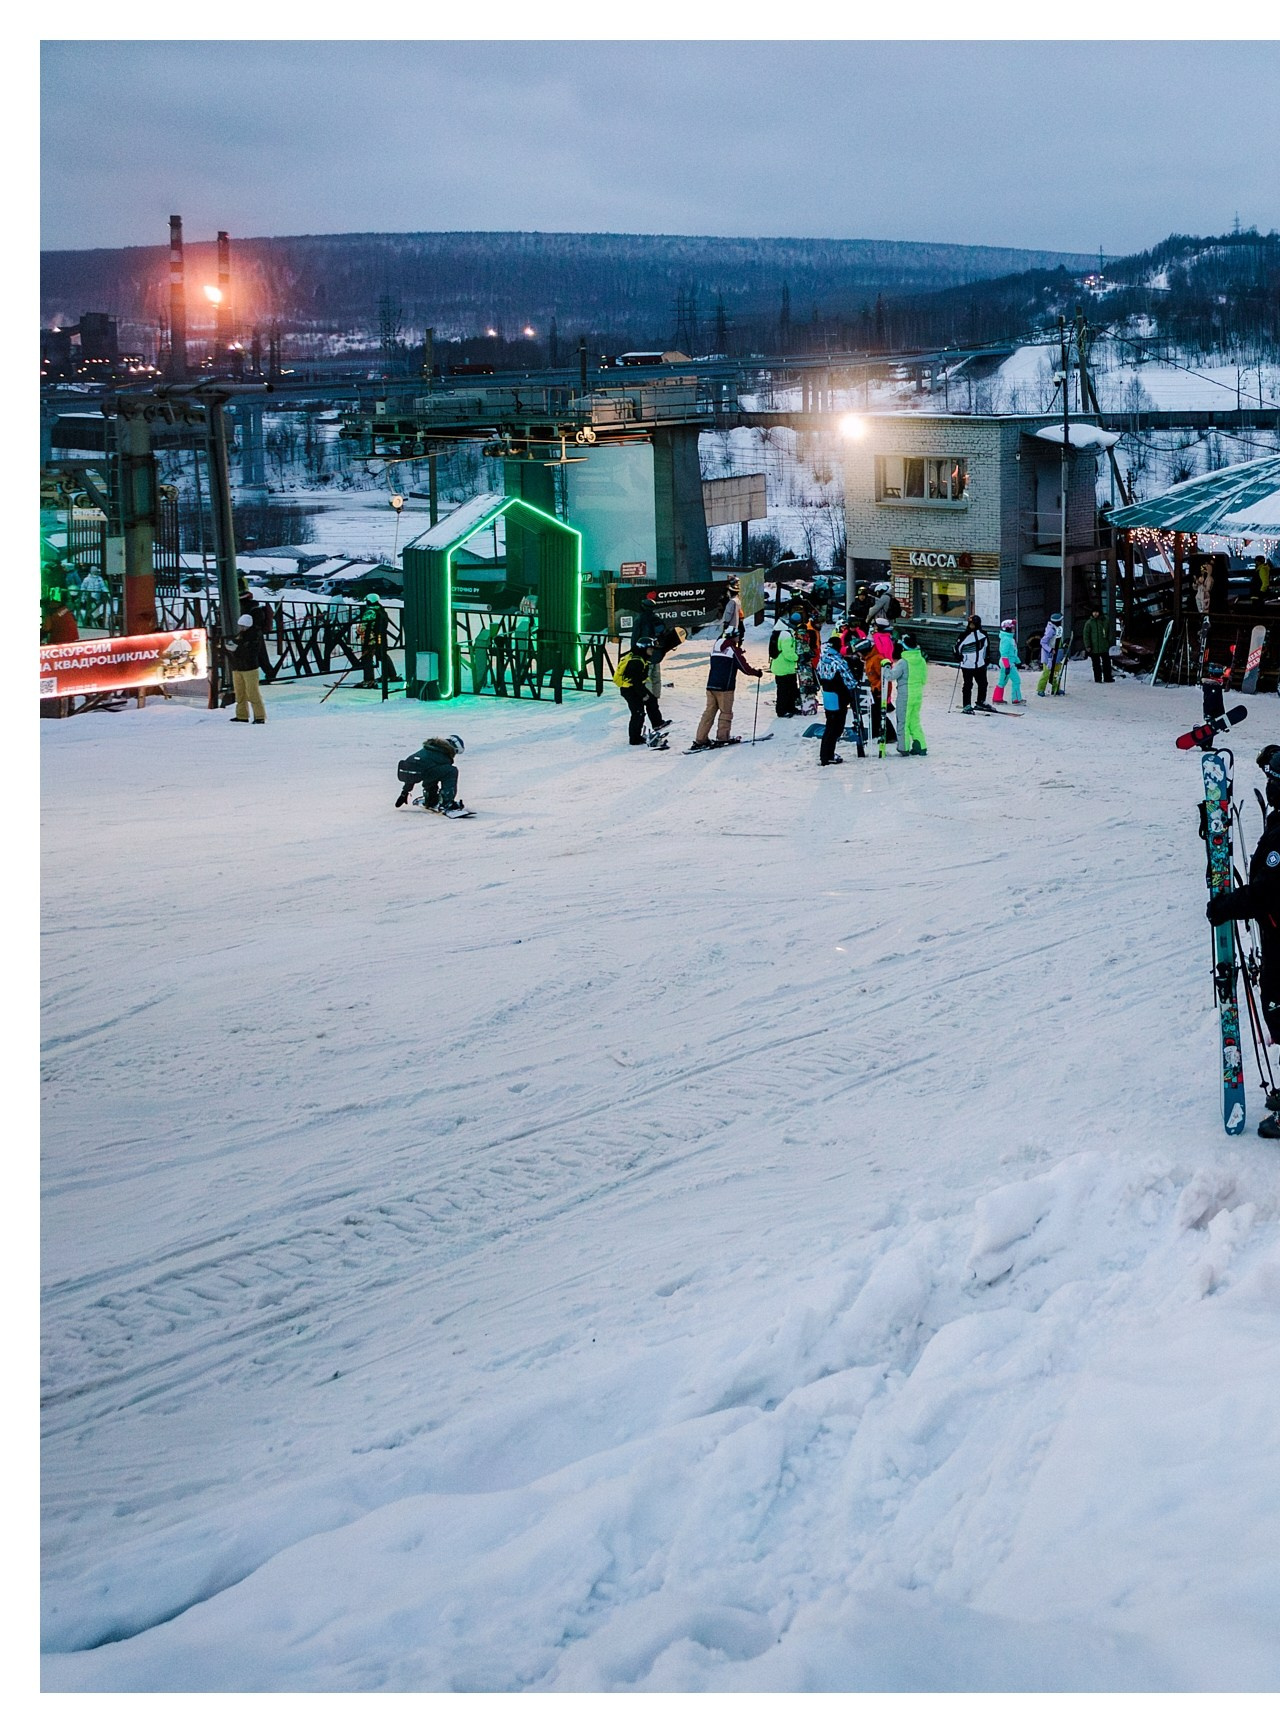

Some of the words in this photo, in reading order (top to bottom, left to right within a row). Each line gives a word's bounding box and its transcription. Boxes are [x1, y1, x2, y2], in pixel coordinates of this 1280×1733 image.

[909, 551, 957, 568] КАССА
[658, 590, 694, 598] СУТОЧНО
[680, 607, 706, 617] есть!
[54, 649, 160, 671] КВАДРОЦИКЛАХ
